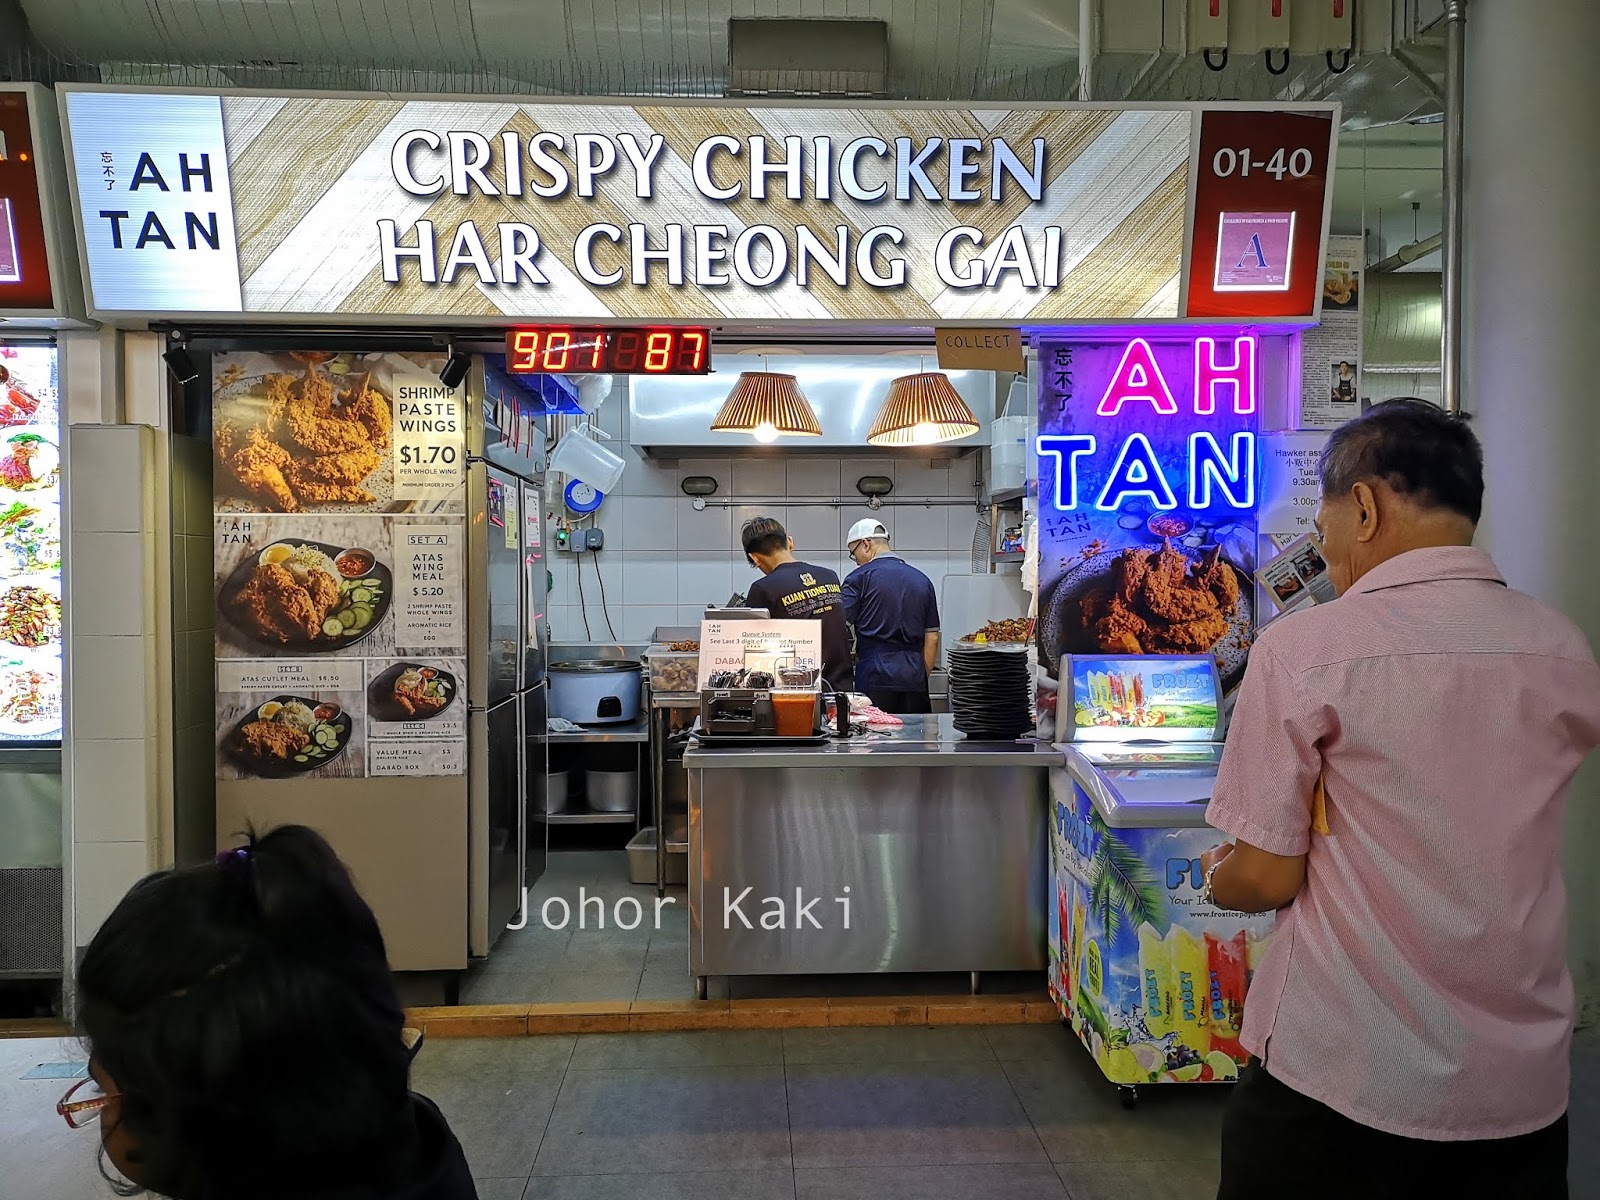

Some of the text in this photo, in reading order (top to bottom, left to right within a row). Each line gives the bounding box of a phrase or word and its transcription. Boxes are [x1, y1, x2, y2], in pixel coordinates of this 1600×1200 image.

[100, 151, 116, 191] 忘不了
[129, 152, 213, 193] AH
[390, 129, 1046, 201] CRISPY CHICKEN
[1212, 147, 1313, 181] 01-40
[99, 209, 220, 250] TAN
[377, 218, 1062, 290] HAR CHEONG GAI
[1234, 232, 1271, 269] A
[512, 331, 704, 370] 901 87
[945, 334, 1010, 349] COLLECT
[1054, 347, 1073, 412] 忘不了
[1096, 336, 1256, 417] AH
[399, 386, 455, 399] SHRIMP
[399, 403, 455, 415] PASTE
[399, 420, 456, 432] WINGS
[399, 444, 456, 466] $1.70
[1275, 449, 1307, 458] Hawker
[1035, 431, 1255, 511] TAN
[1298, 468, 1320, 477] Tues
[1292, 497, 1319, 508] 3.00p
[230, 521, 250, 531] AH
[1057, 512, 1088, 526] AH
[1295, 517, 1310, 526] Tel:
[222, 533, 250, 543] TAN
[1045, 522, 1091, 538] TAN
[412, 553, 443, 561] ATAS
[781, 591, 806, 607] KUAN
[803, 585, 827, 598] TIONG
[1168, 895, 1193, 906] Your
[1179, 970, 1197, 1021] FROZT
